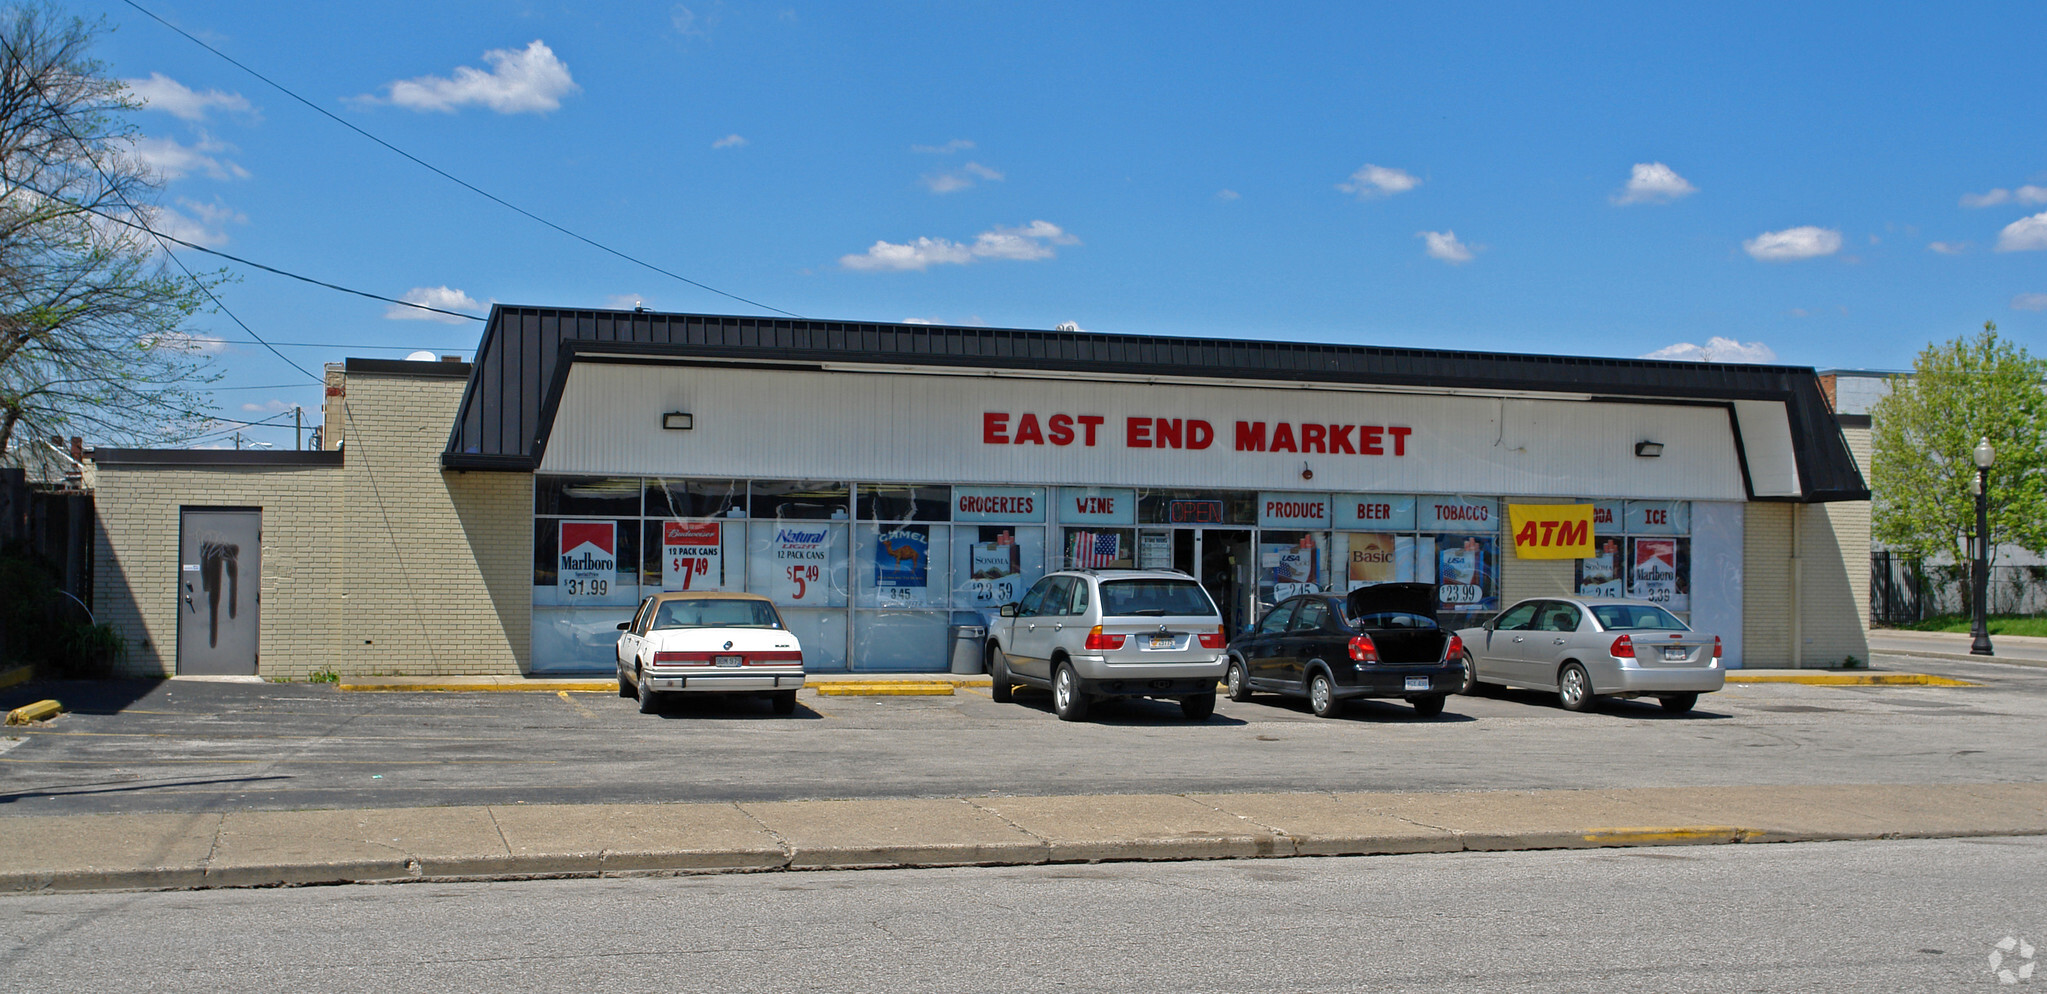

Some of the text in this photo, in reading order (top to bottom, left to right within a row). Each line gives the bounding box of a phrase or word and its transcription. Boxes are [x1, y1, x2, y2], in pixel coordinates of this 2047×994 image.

[984, 413, 1412, 456] EAST END MARKET
[959, 496, 1033, 513] GROCERIES
[1076, 497, 1114, 513] WINE
[1172, 502, 1221, 522] OPEN
[1266, 502, 1324, 518] PRODUCE
[1357, 503, 1390, 519] BEER
[1435, 505, 1488, 521] TOBACCO
[1593, 508, 1613, 523] ODA
[1645, 509, 1667, 525] ICE
[667, 529, 714, 537] Budweiser
[775, 529, 828, 543] Natural
[879, 530, 927, 545] CAMEL
[1516, 520, 1588, 546] ATM
[668, 547, 718, 555] 12 PACK CANS
[787, 551, 804, 559] PACK
[1353, 551, 1393, 563] Basic
[561, 552, 613, 570] Marlboro
[975, 556, 1009, 565] SONOMA
[1637, 565, 1674, 580] Marlboro
